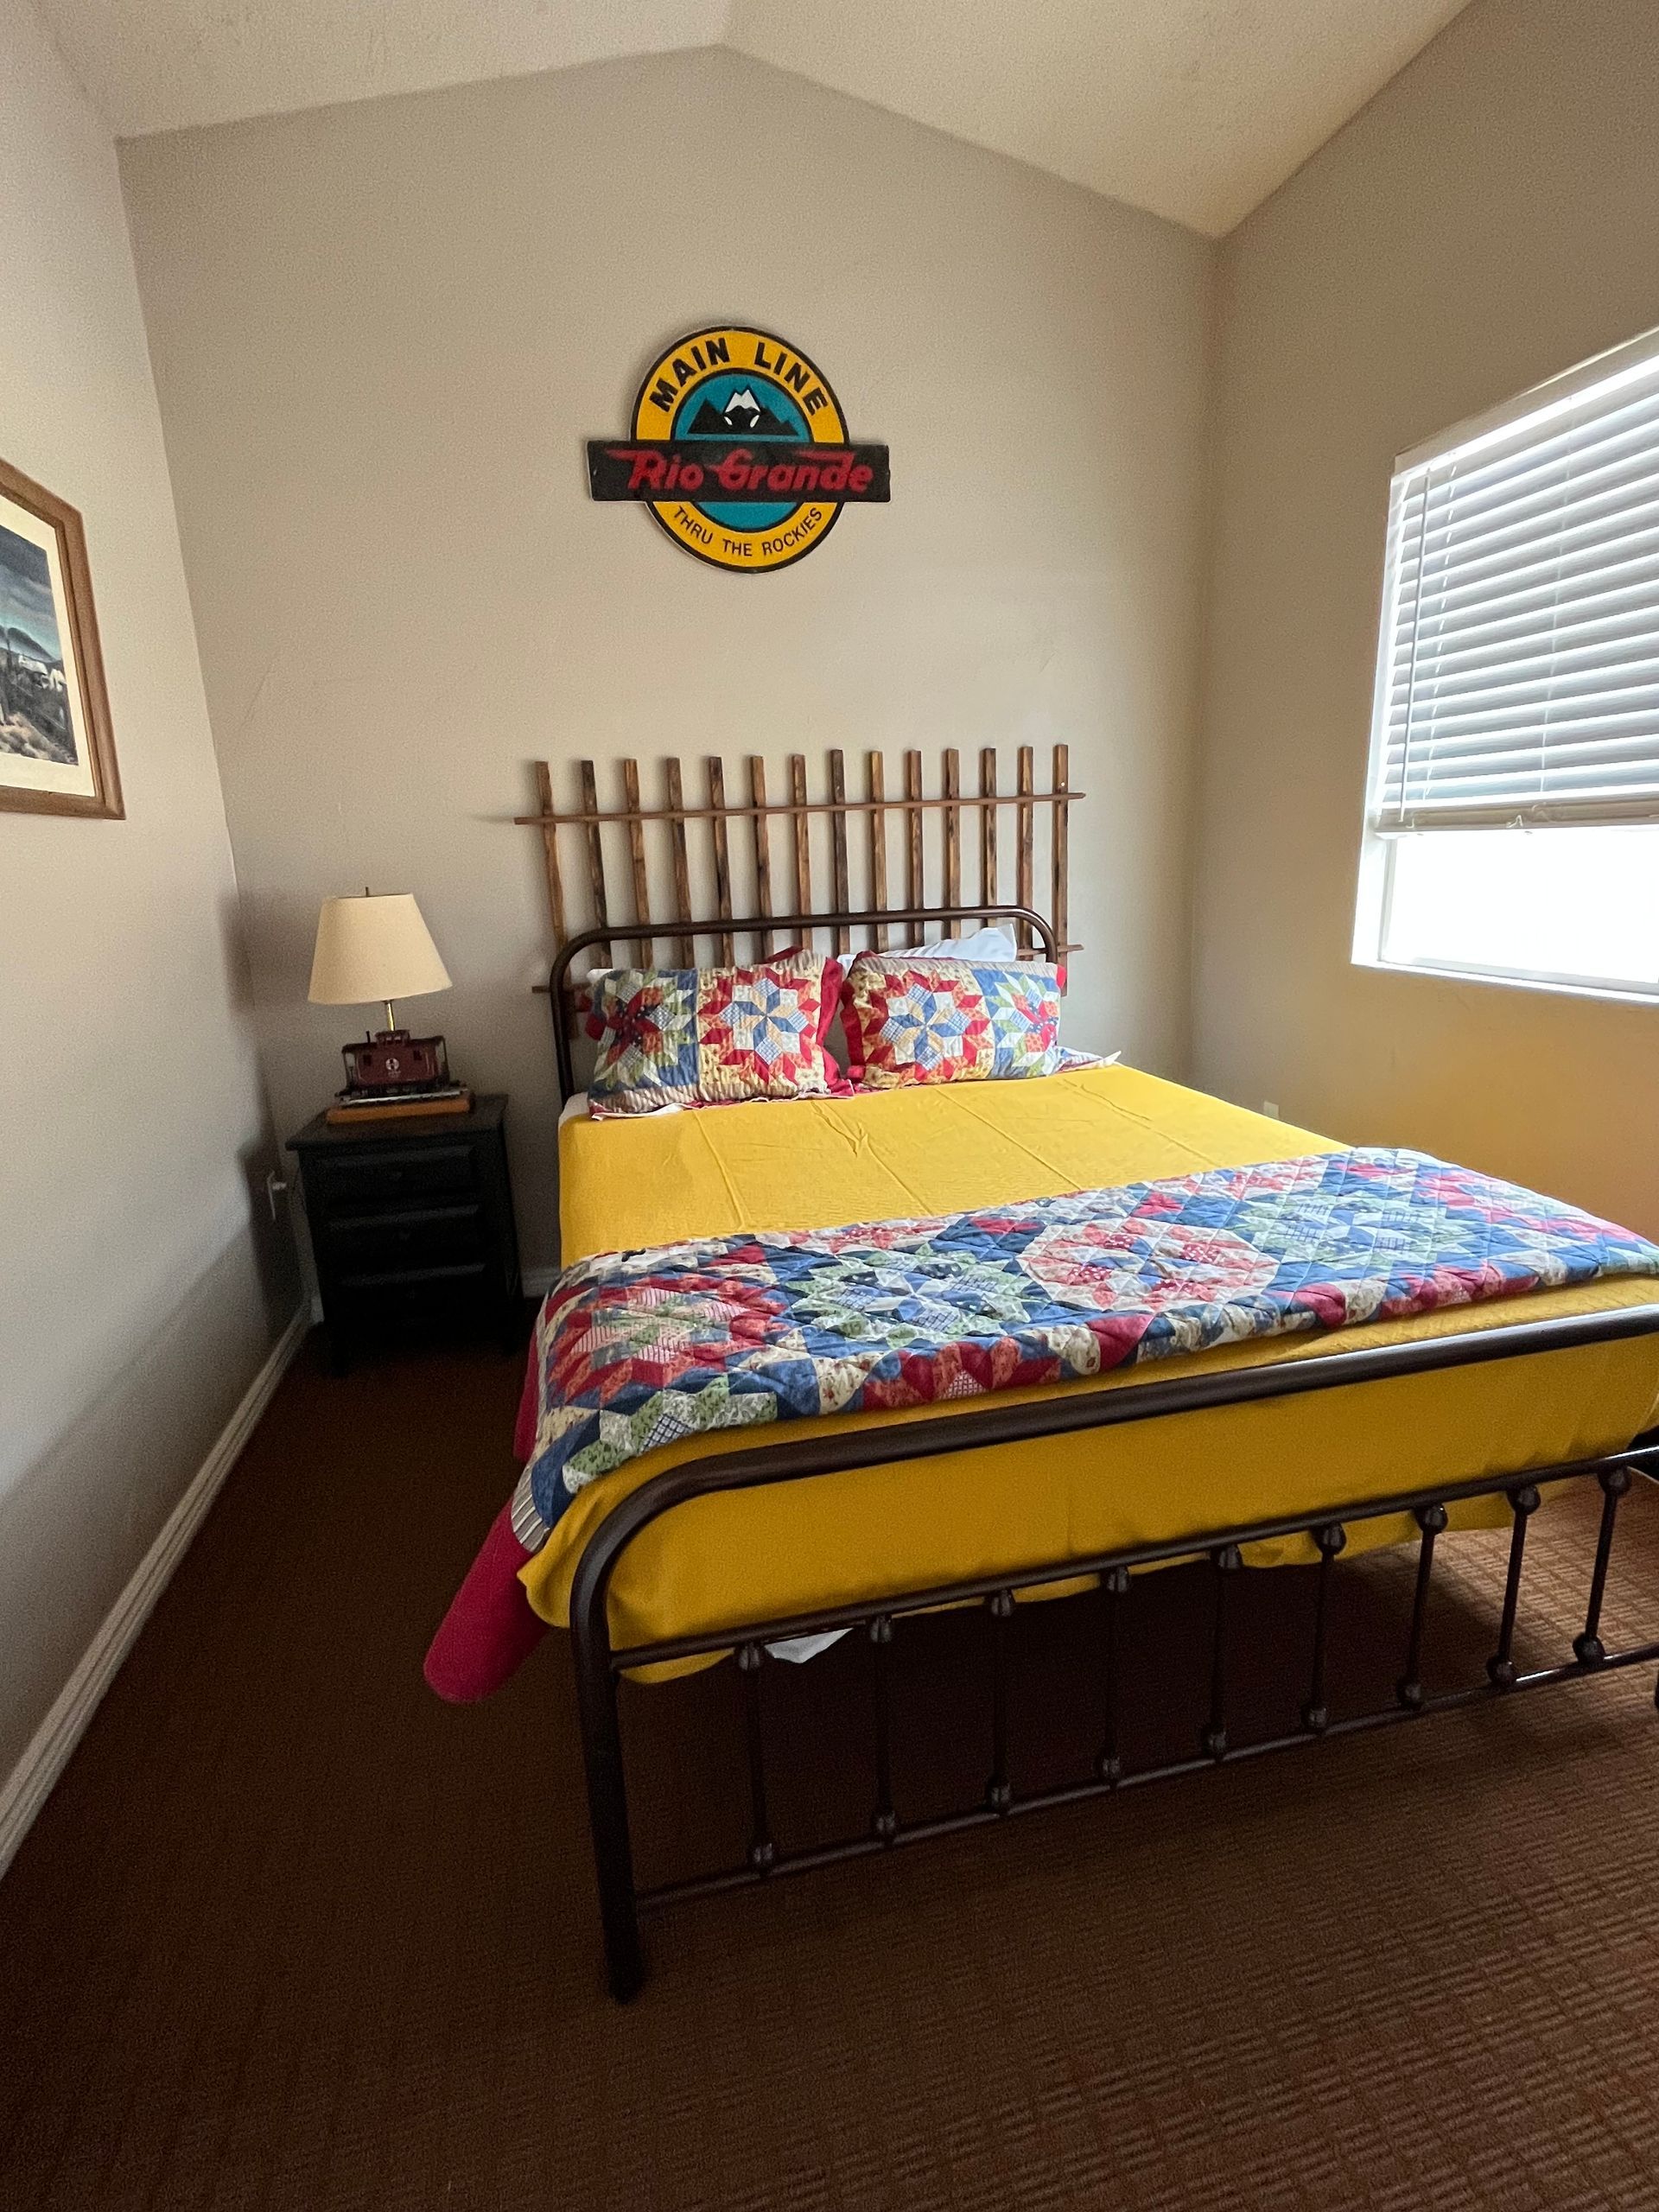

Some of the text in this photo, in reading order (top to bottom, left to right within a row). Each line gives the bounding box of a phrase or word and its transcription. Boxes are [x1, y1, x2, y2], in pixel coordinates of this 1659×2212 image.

[650, 337, 829, 416] MAIN LINE
[607, 448, 874, 492] Rio Grande
[674, 506, 823, 556] THRU THE ROCKIES
